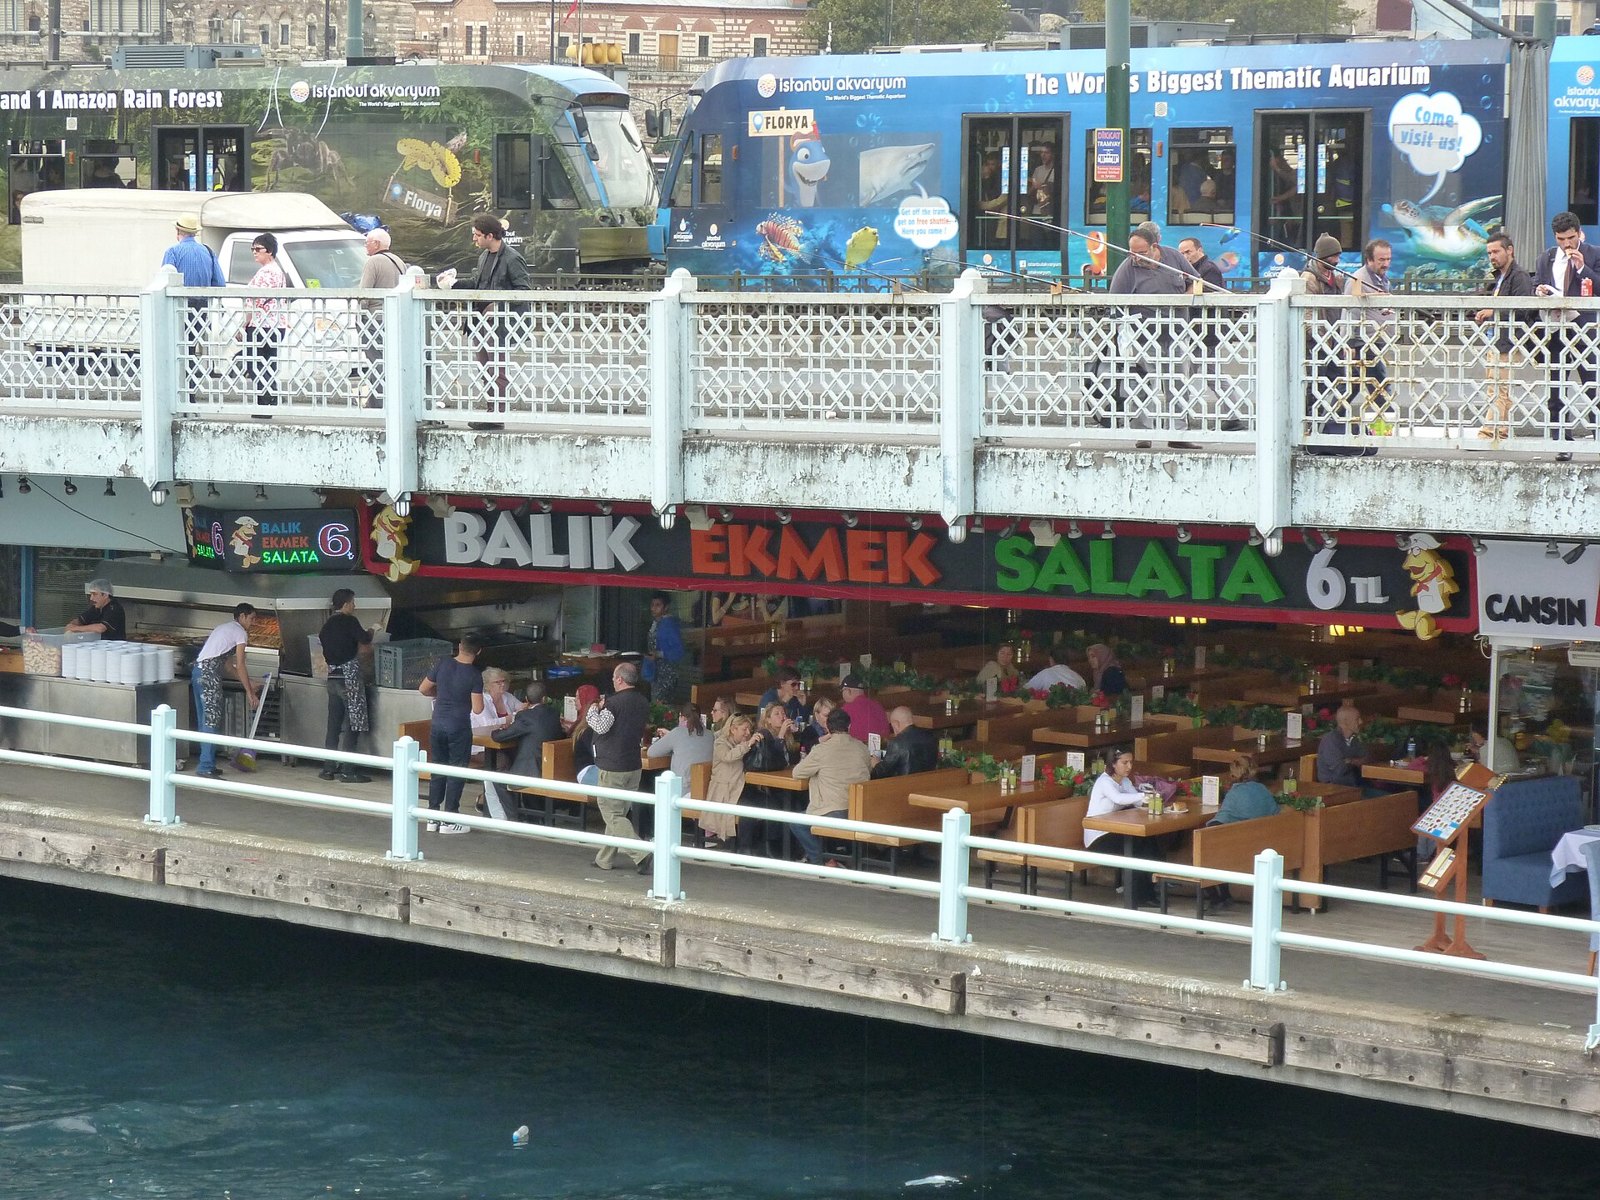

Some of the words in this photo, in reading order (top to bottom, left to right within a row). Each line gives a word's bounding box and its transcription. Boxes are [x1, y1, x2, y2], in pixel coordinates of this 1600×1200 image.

[779, 77, 834, 92] istanbul
[836, 76, 906, 93] akvaryum
[1025, 73, 1059, 95] The
[1066, 72, 1139, 94] Wors
[1147, 69, 1222, 94] Biggest
[1230, 66, 1321, 90] Thematic
[1328, 63, 1430, 89] Aquarium
[0, 90, 31, 109] and
[37, 90, 46, 109] 1
[52, 90, 117, 109] Amazon
[123, 89, 162, 109] Rain
[169, 89, 223, 108] Forest
[370, 84, 440, 100] akvaryum
[765, 116, 808, 130] FLORYA
[1415, 106, 1455, 128] Come
[1401, 129, 1434, 148] visit
[1438, 136, 1463, 152] us!
[404, 190, 442, 218] Florya
[261, 522, 301, 534] BALIK
[262, 536, 309, 549] EKMEK
[262, 550, 319, 563] SALATA
[444, 511, 646, 573] BALIK
[690, 524, 943, 587] EKMEK
[994, 535, 1286, 602] SALATA
[1306, 547, 1346, 610] 6
[1350, 576, 1389, 604] TL
[1485, 593, 1587, 627] CANSIN
